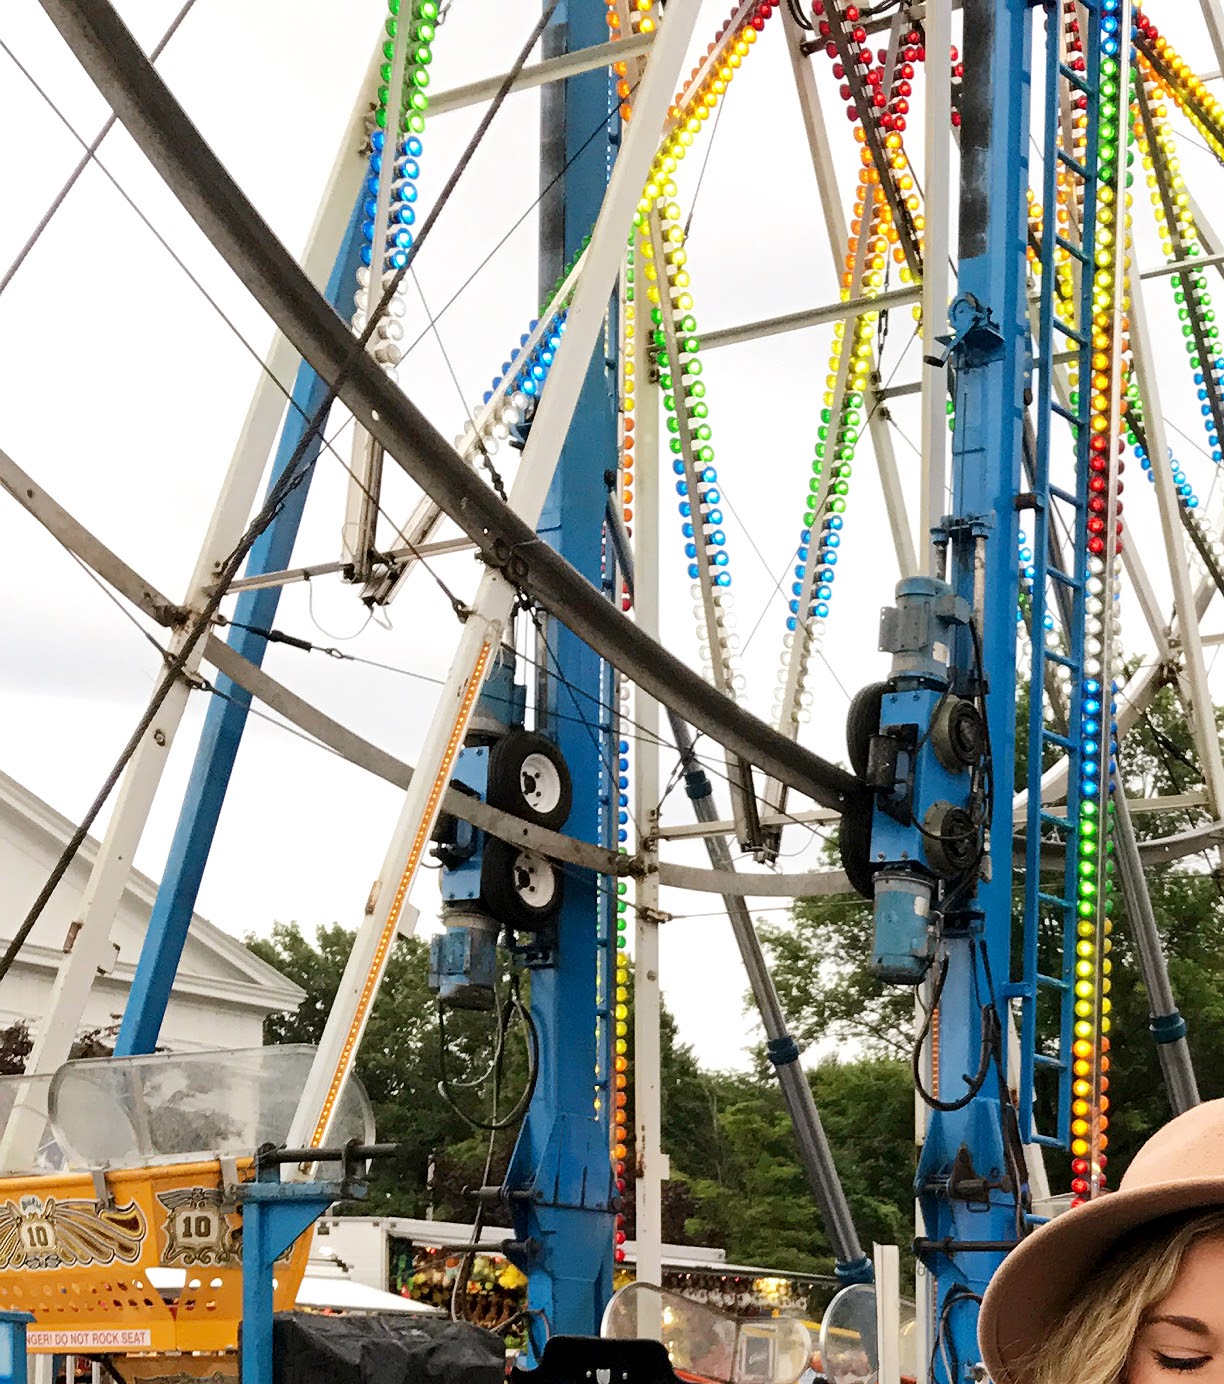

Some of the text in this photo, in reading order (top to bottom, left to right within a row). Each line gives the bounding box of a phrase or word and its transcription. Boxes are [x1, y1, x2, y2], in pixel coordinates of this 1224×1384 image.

[27, 1225, 49, 1247] 10
[182, 1215, 211, 1238] 10
[55, 1333, 68, 1345] DO
[71, 1333, 90, 1345] NOT
[93, 1332, 119, 1345] ROCK
[120, 1332, 146, 1344] SEAT
